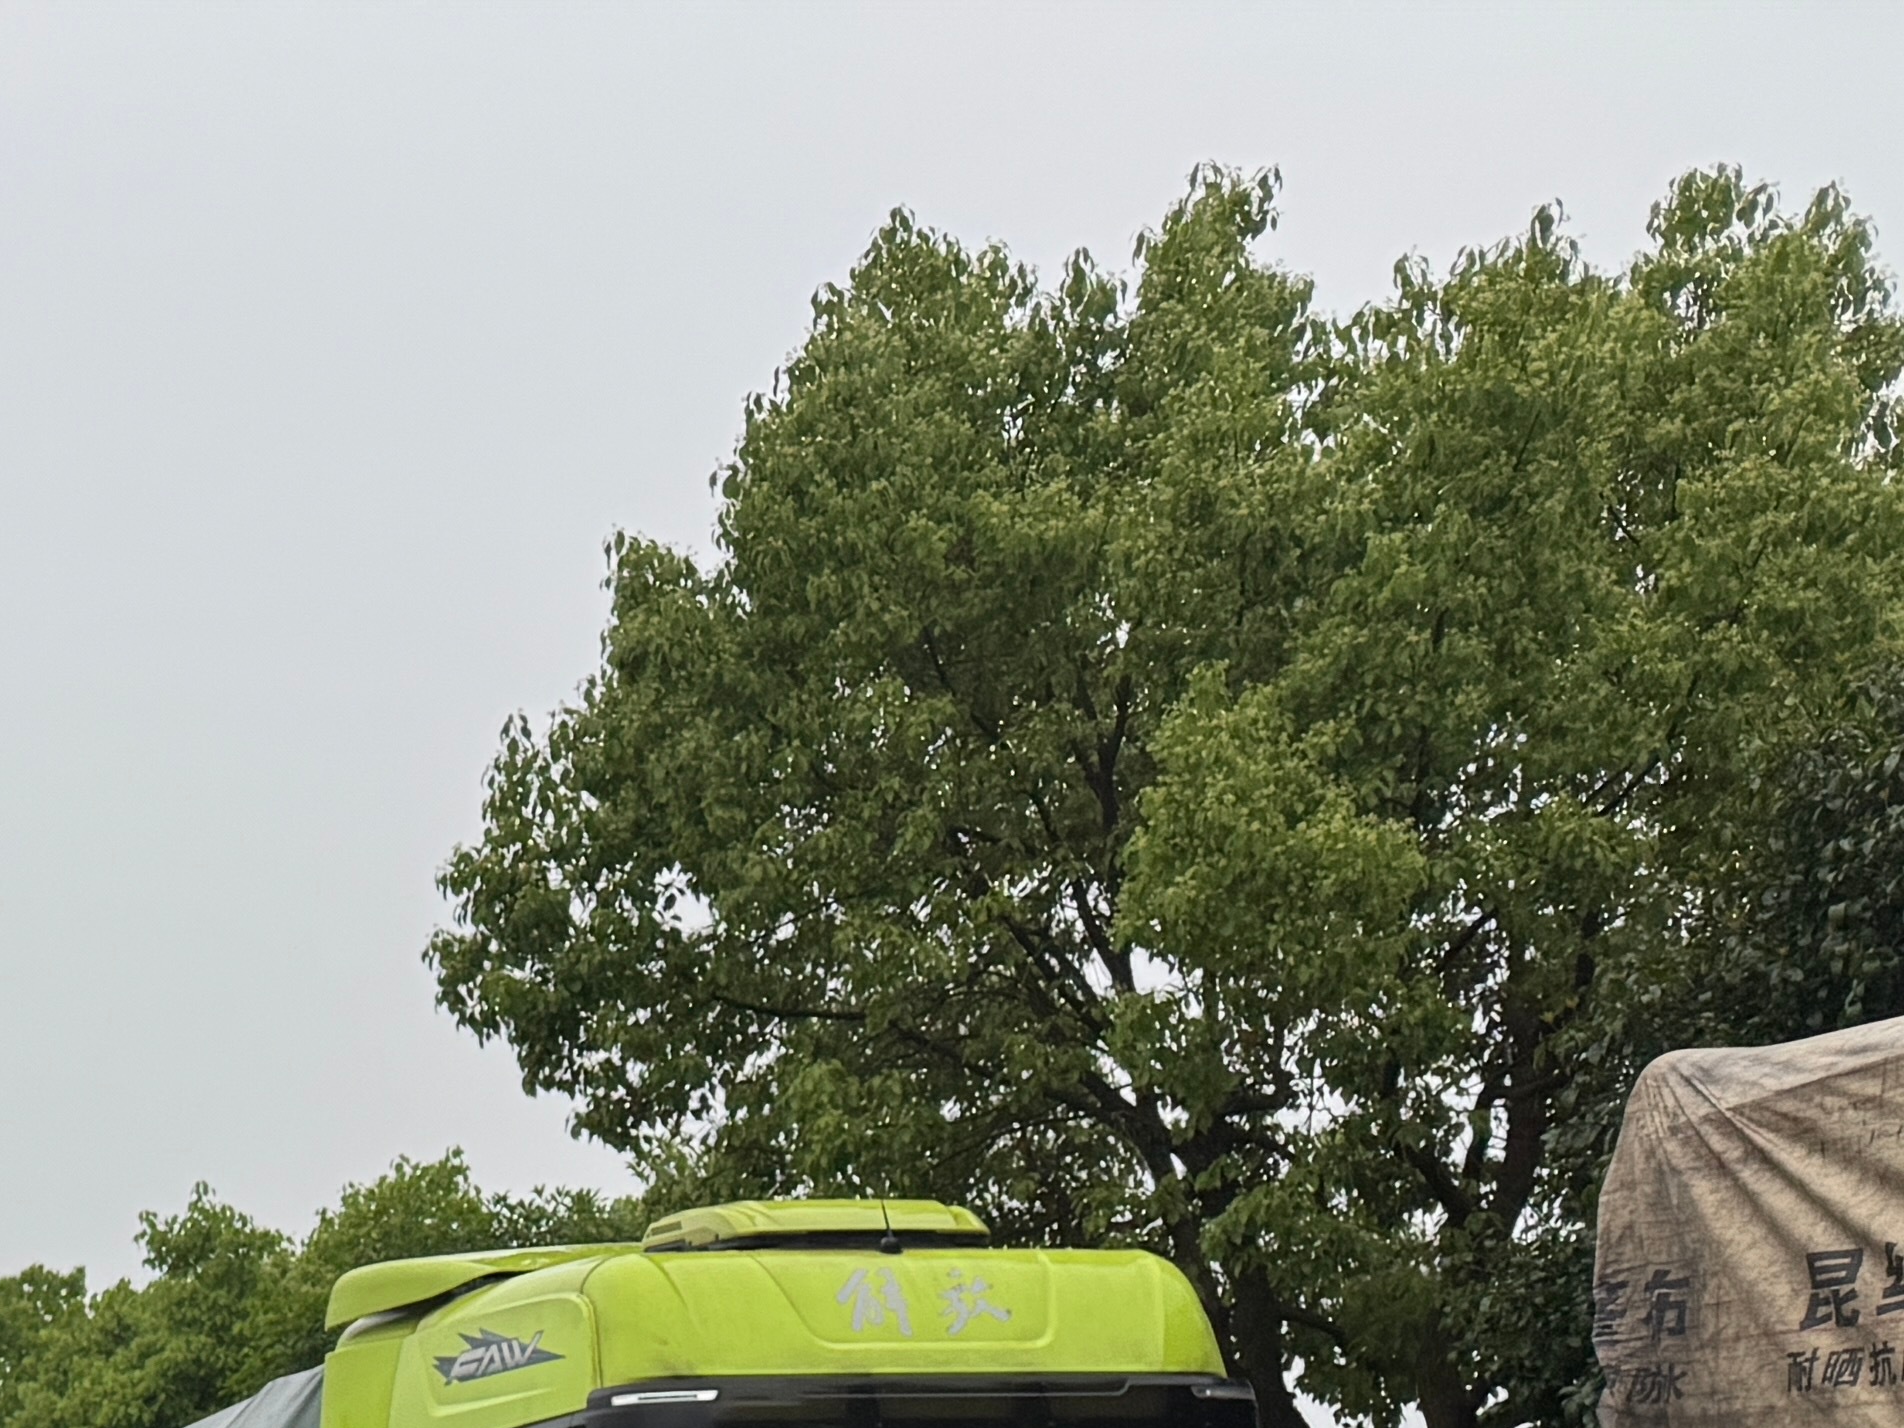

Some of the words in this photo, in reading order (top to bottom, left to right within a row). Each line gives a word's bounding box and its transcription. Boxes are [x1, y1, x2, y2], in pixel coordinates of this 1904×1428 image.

[1604, 1362, 1687, 1404] 防水
[1787, 1341, 1904, 1393] 耐晒抗
